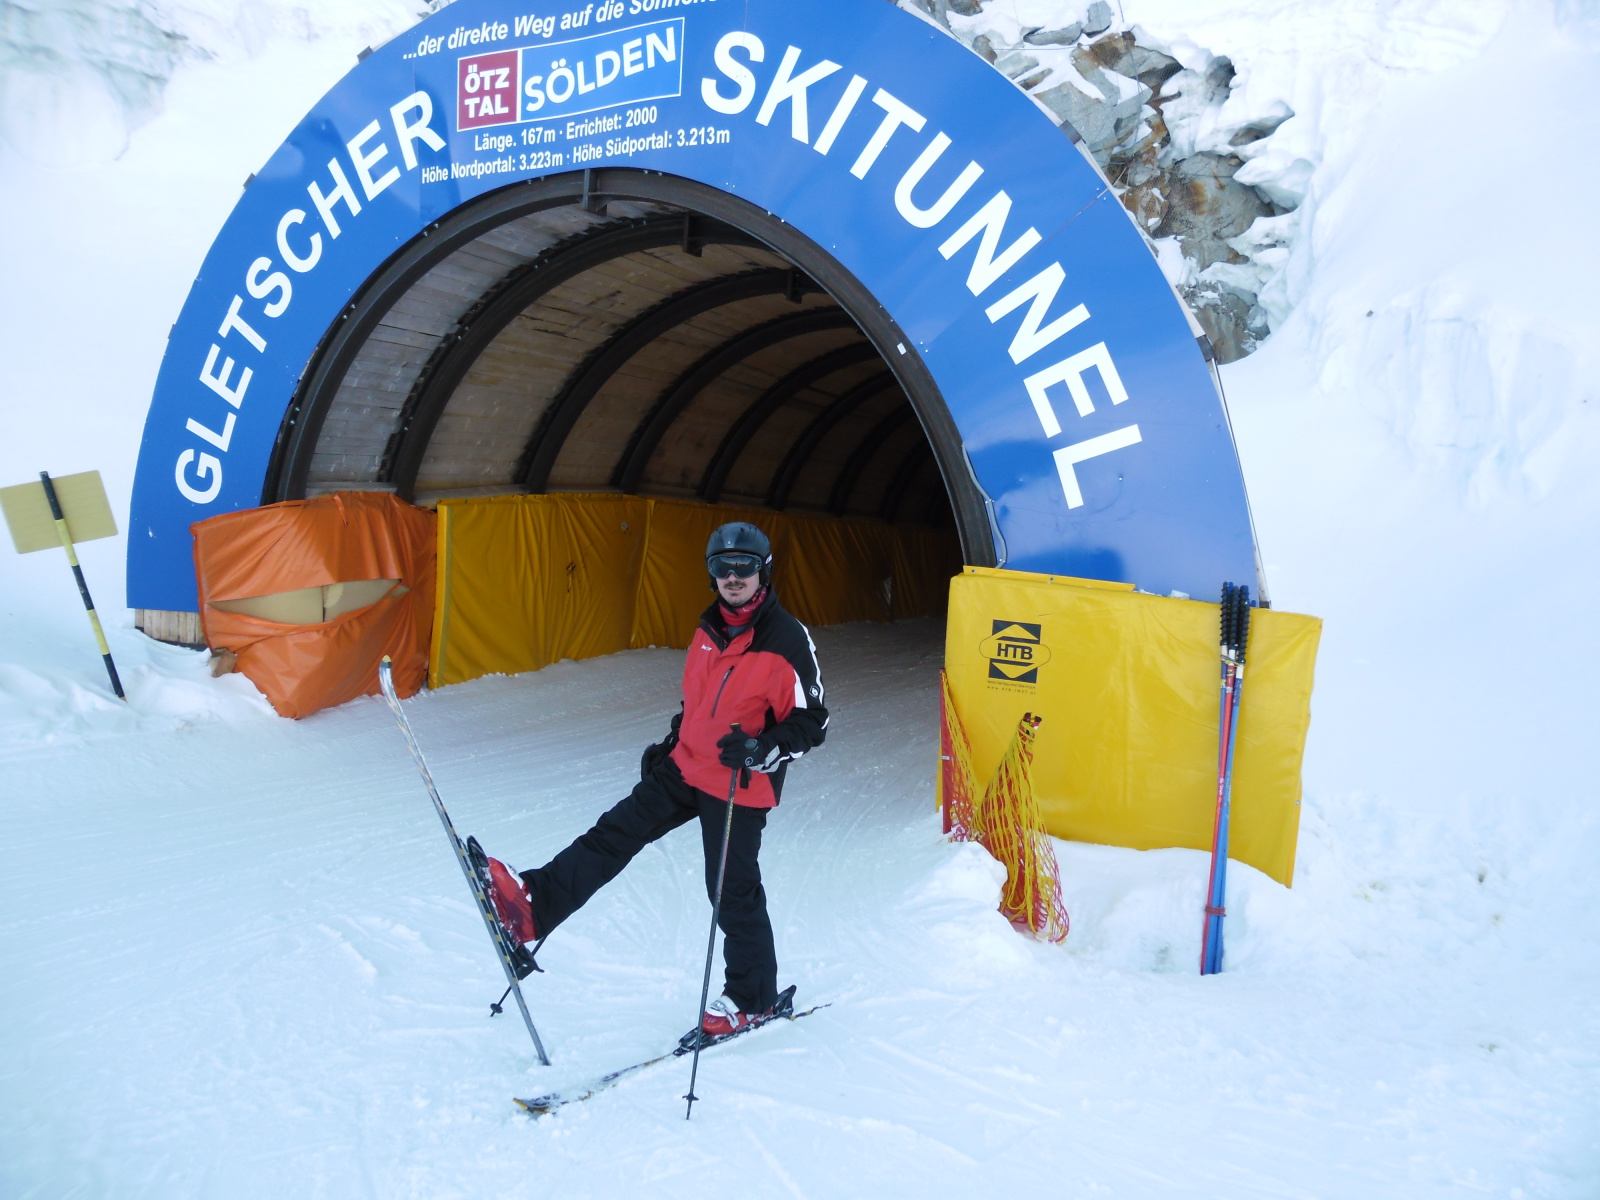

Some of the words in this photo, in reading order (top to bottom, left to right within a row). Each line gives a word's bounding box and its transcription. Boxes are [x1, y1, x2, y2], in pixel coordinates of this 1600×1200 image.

[447, 20, 509, 50] direkte
[514, 14, 556, 39] Weg
[560, 4, 594, 30] auf
[595, 0, 625, 23] die
[464, 64, 510, 93] ÖTZ
[524, 26, 677, 112] SÖLDEN
[464, 94, 509, 119] TAL
[475, 133, 517, 153] Länge.
[566, 113, 622, 140] Errichtet:
[625, 105, 658, 128] 2000
[421, 166, 449, 184] Höhe
[451, 155, 516, 179] Nordportal:
[572, 143, 603, 163] Höhe
[605, 130, 673, 157] Südportal:
[700, 30, 1143, 511] SKITUNNEL
[174, 90, 447, 505] GLETSCHER
[997, 642, 1033, 660] HTB
